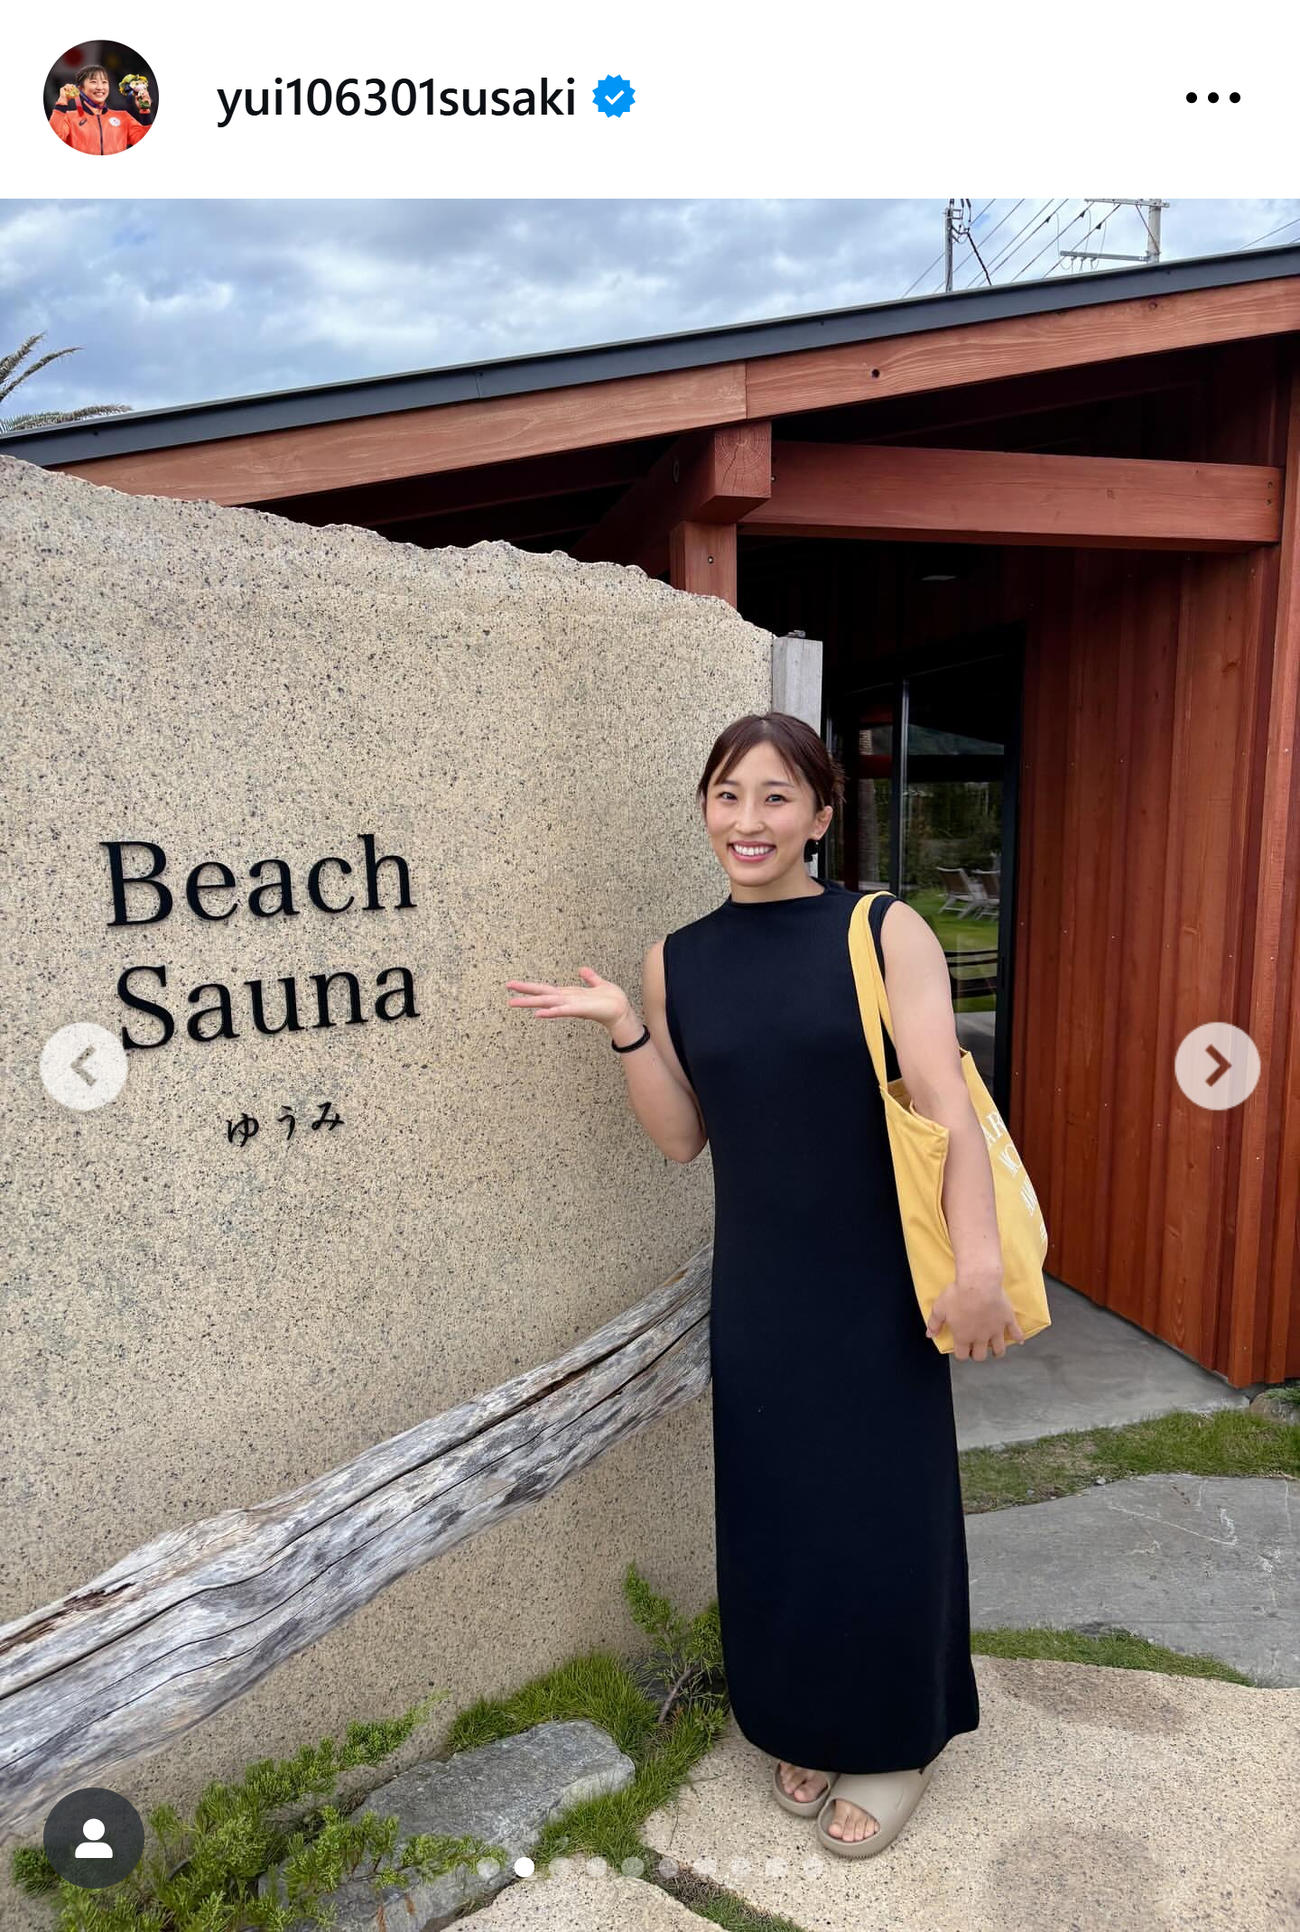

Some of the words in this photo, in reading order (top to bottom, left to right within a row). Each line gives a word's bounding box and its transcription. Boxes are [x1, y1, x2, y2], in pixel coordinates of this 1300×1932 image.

[100, 834, 418, 927] Beach
[117, 965, 421, 1050] Sauna
[226, 1102, 345, 1148] ゆうみ
